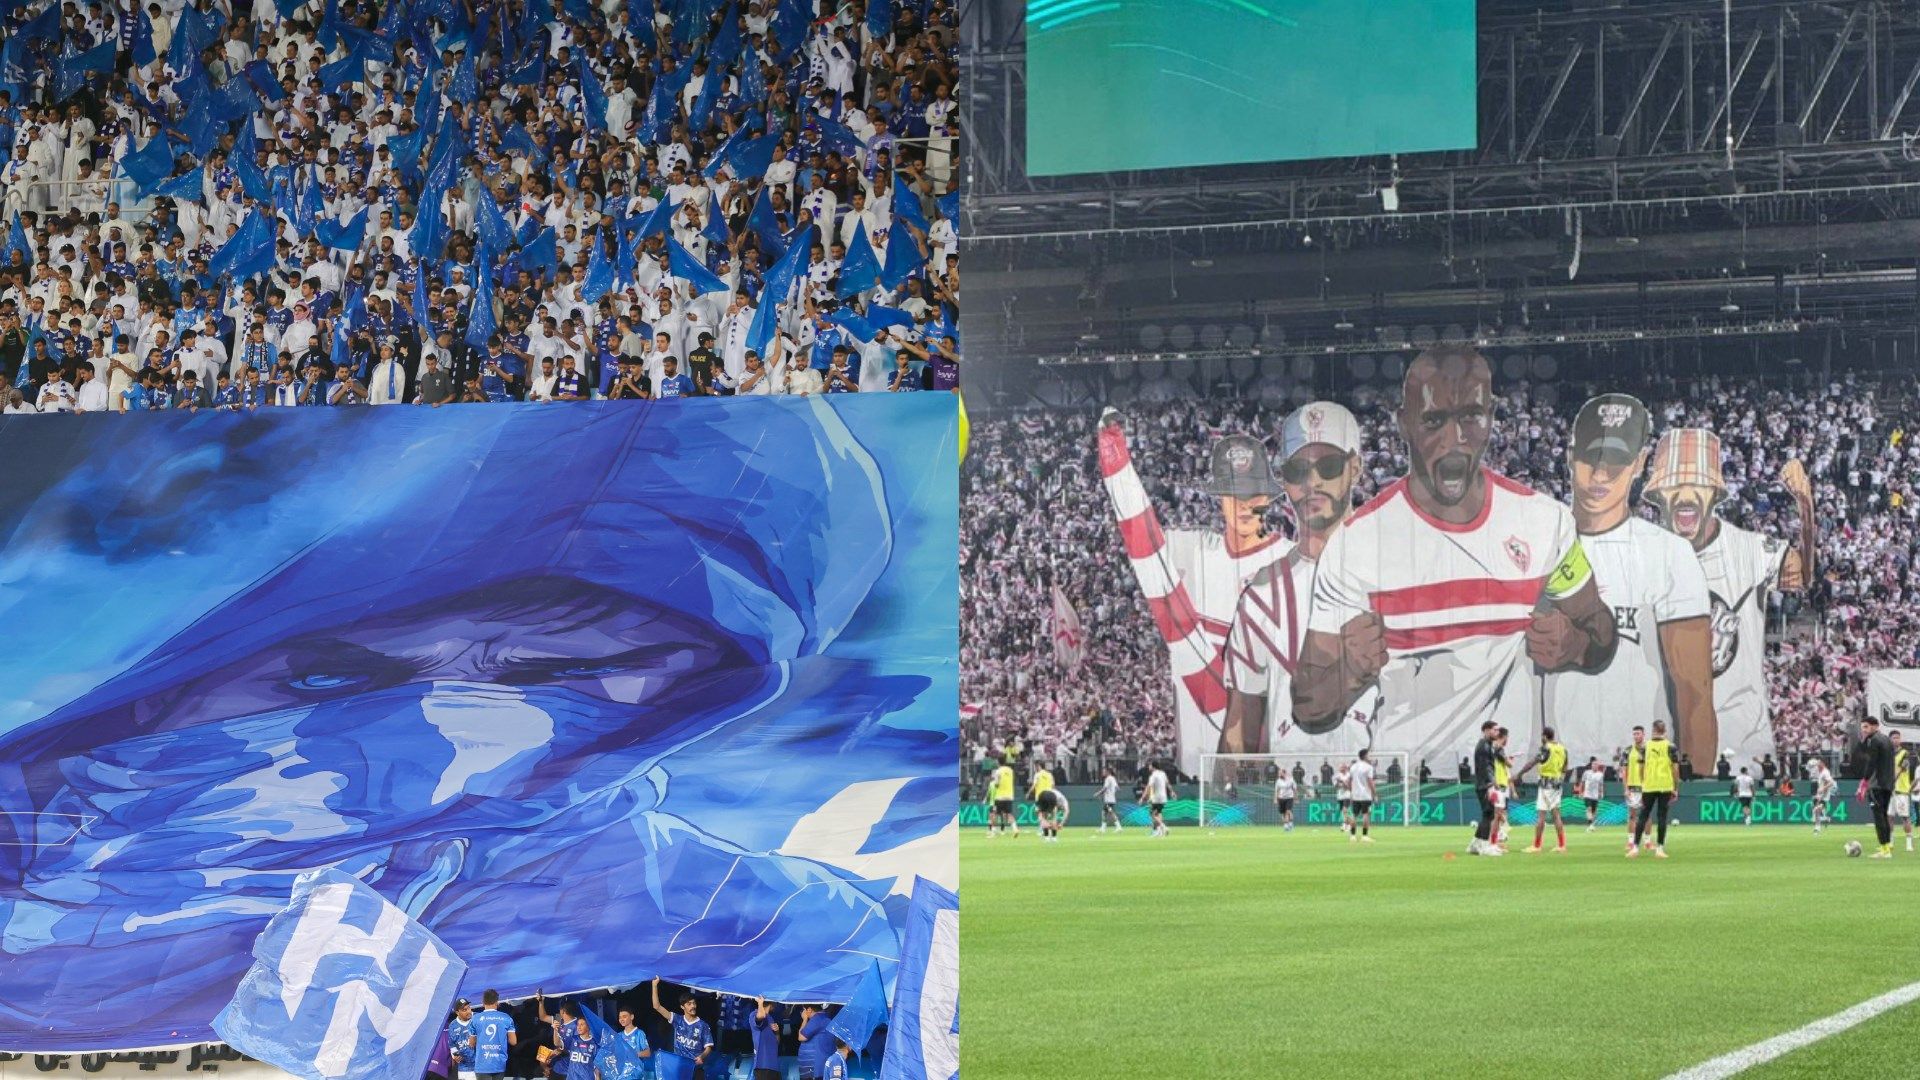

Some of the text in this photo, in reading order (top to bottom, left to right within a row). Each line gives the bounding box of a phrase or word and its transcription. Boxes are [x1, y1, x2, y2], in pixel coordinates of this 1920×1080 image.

[1614, 606, 1639, 630] EK
[1391, 802, 1445, 822] 2024
[1789, 801, 1847, 821] 204
[486, 1023, 498, 1042] 9
